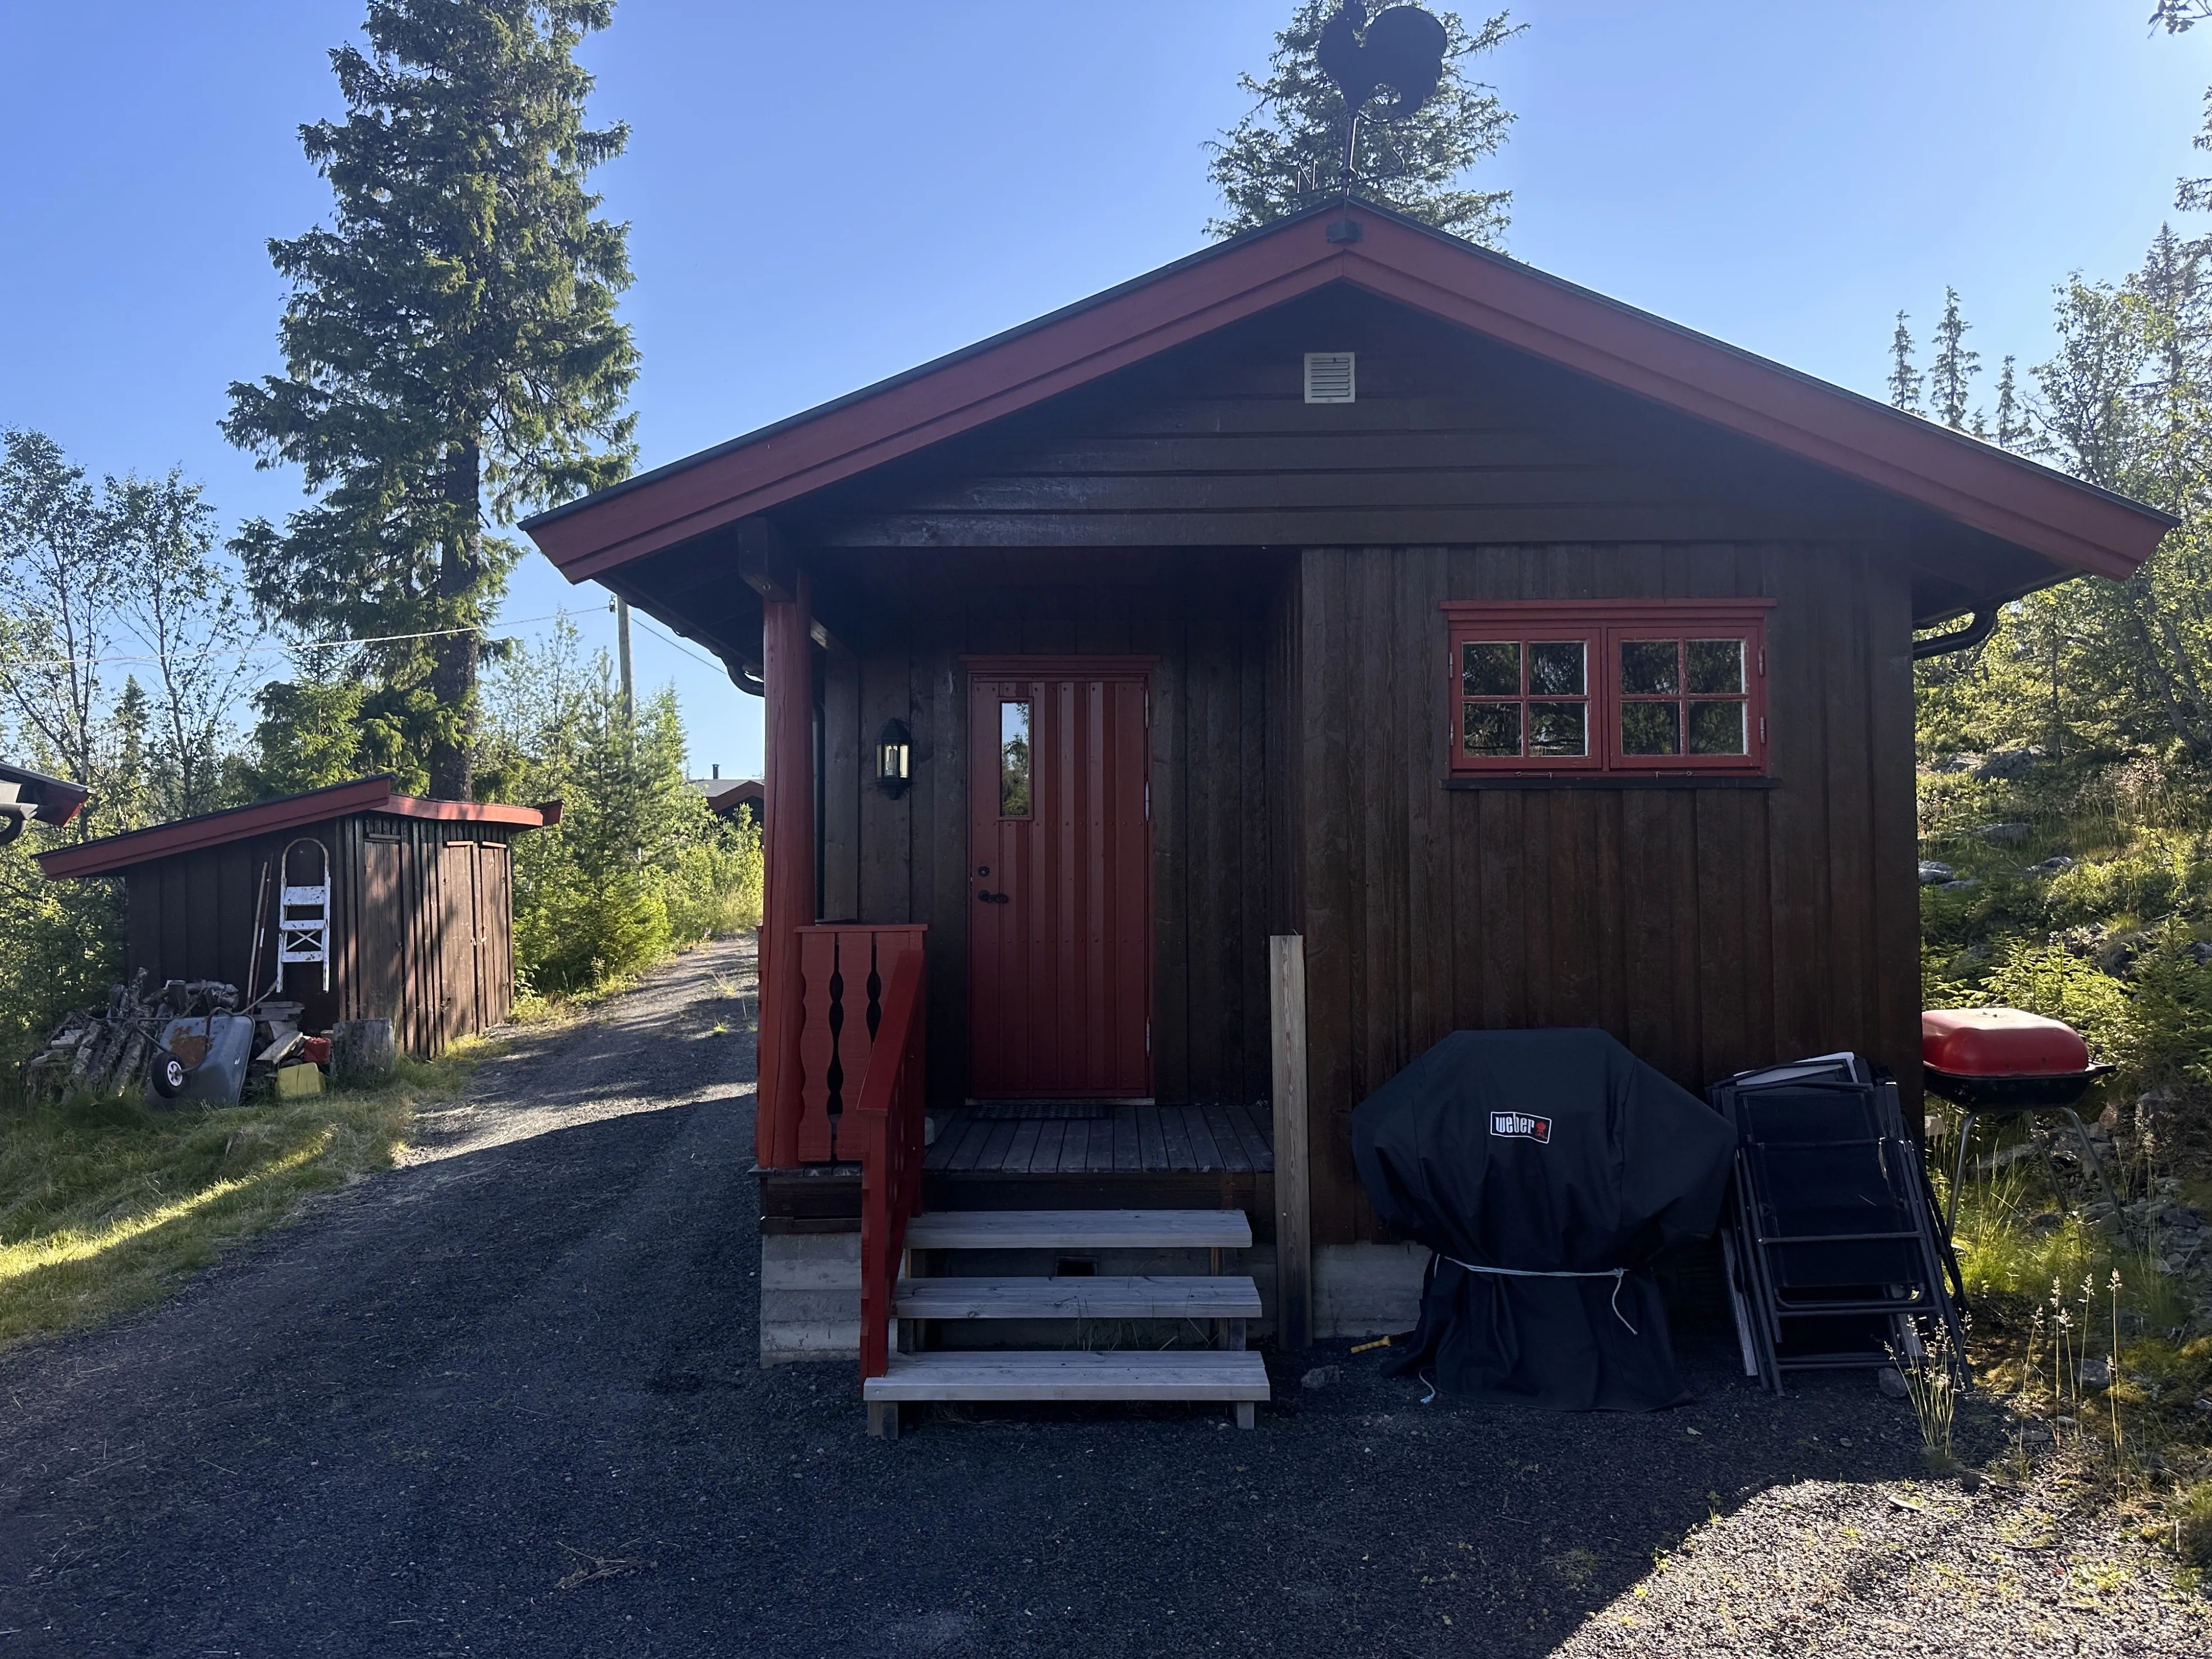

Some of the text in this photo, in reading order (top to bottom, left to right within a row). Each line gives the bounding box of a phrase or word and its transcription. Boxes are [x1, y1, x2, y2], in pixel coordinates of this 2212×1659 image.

[1390, 140, 1407, 170] S
[1296, 158, 1315, 194] N
[1495, 1113, 1535, 1134] weber
